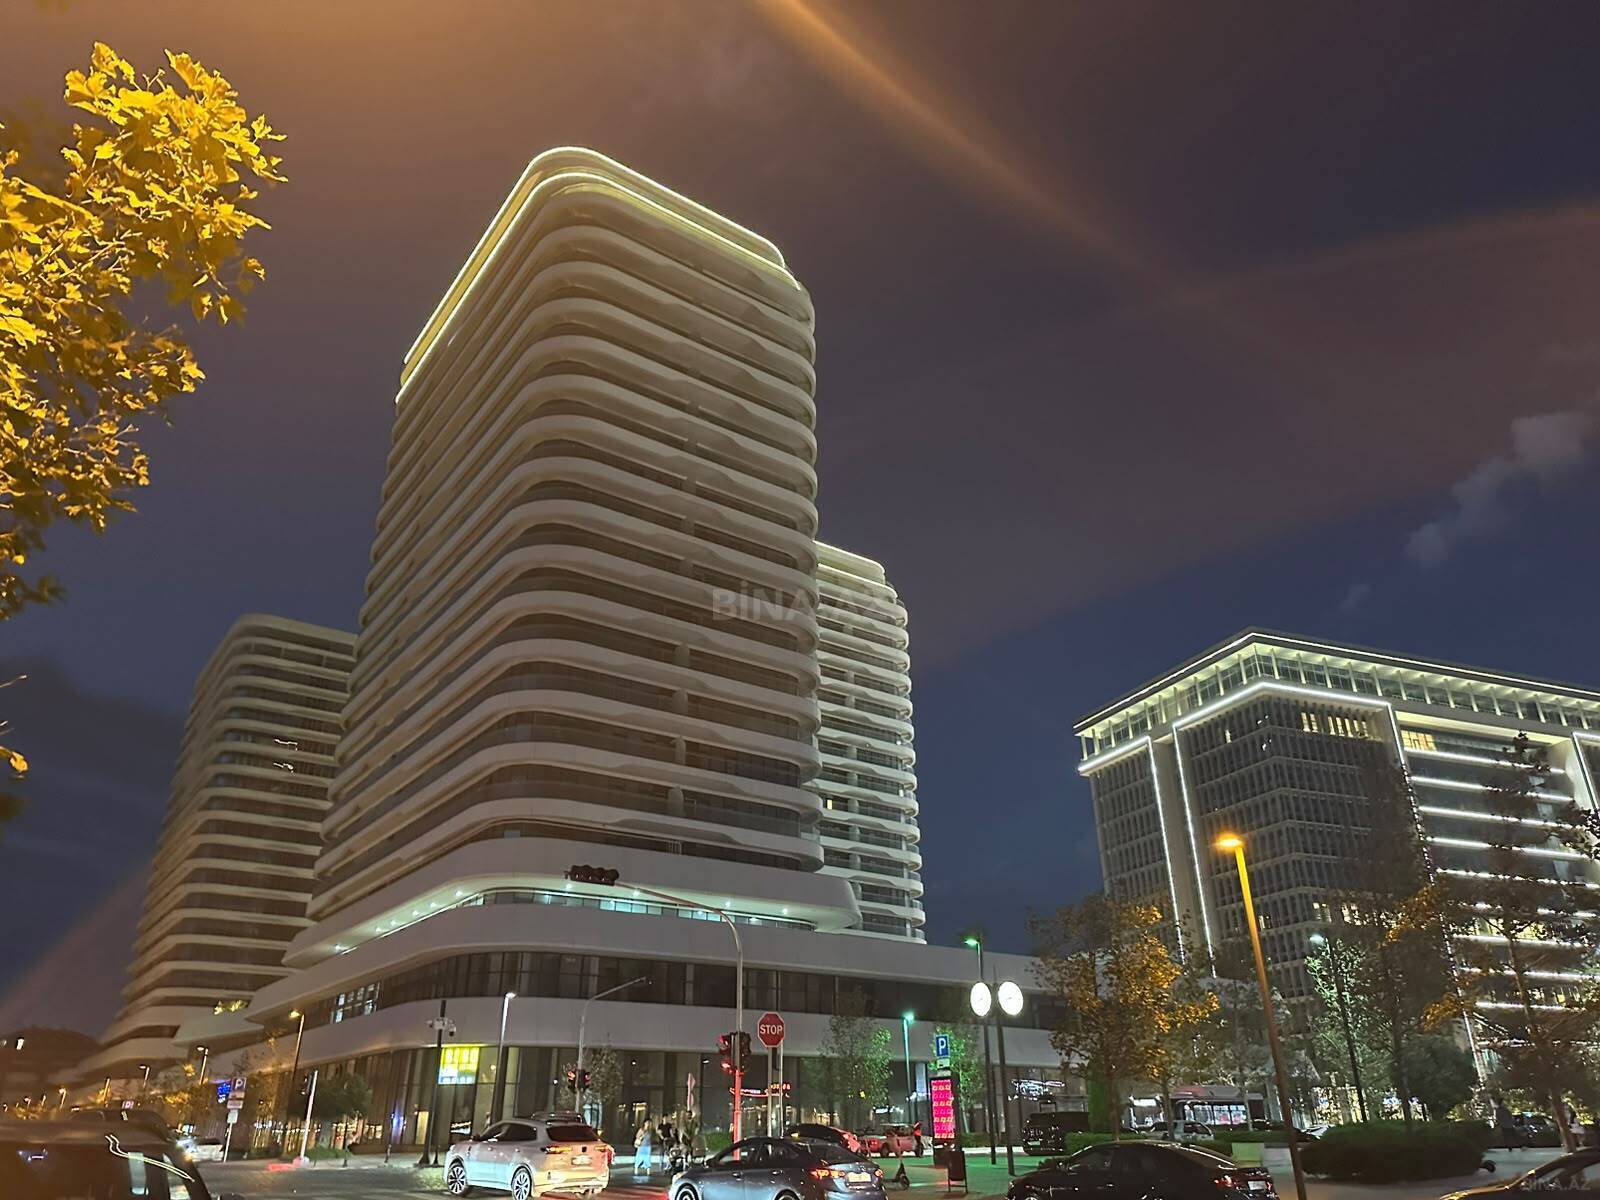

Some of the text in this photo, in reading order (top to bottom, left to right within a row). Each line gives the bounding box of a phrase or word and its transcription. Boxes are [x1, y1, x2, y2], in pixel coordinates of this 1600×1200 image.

[760, 1024, 783, 1035] STOP
[938, 1037, 947, 1055] P
[235, 1078, 243, 1090] P
